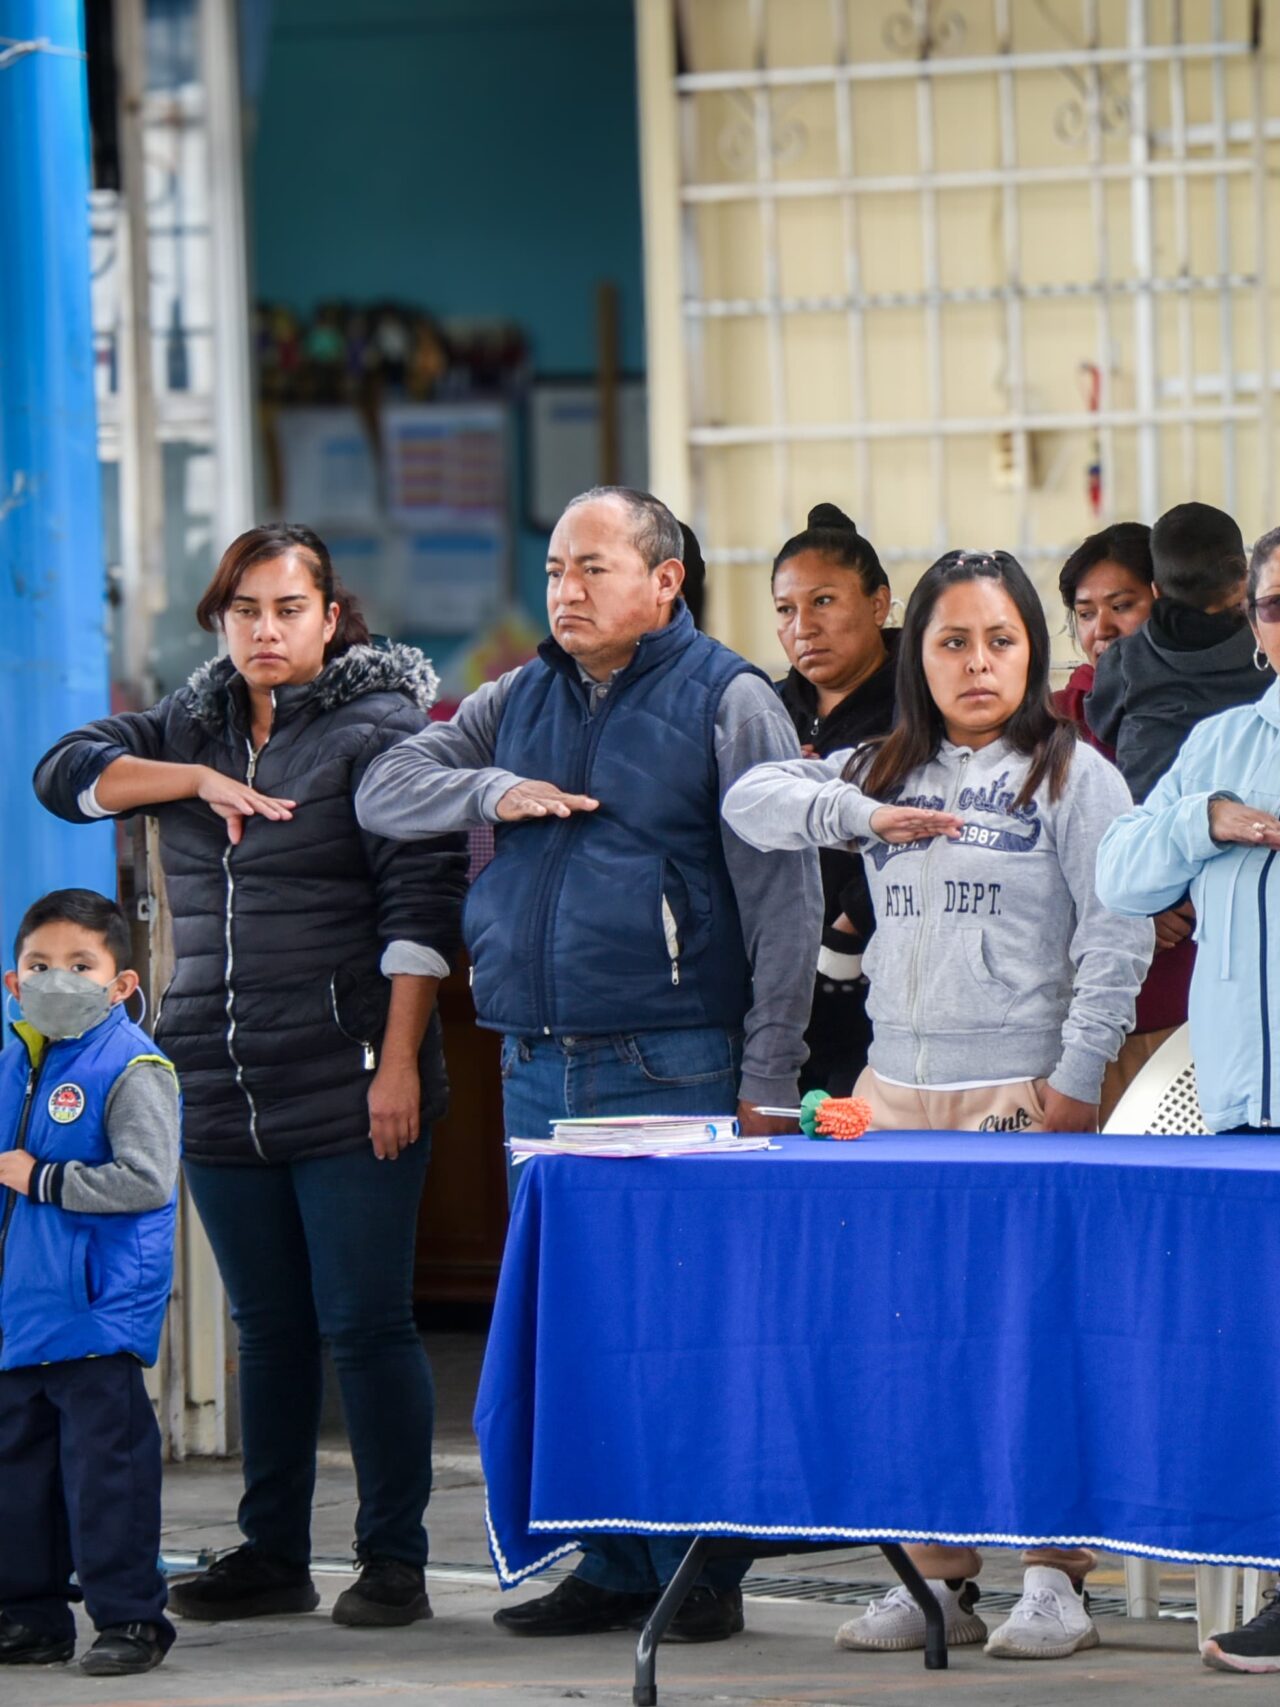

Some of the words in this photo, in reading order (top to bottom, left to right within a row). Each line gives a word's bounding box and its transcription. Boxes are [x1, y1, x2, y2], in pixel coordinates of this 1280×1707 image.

[959, 825, 1001, 847] 1987
[885, 884, 921, 917] ATH.
[943, 880, 1002, 916] DEPT.
